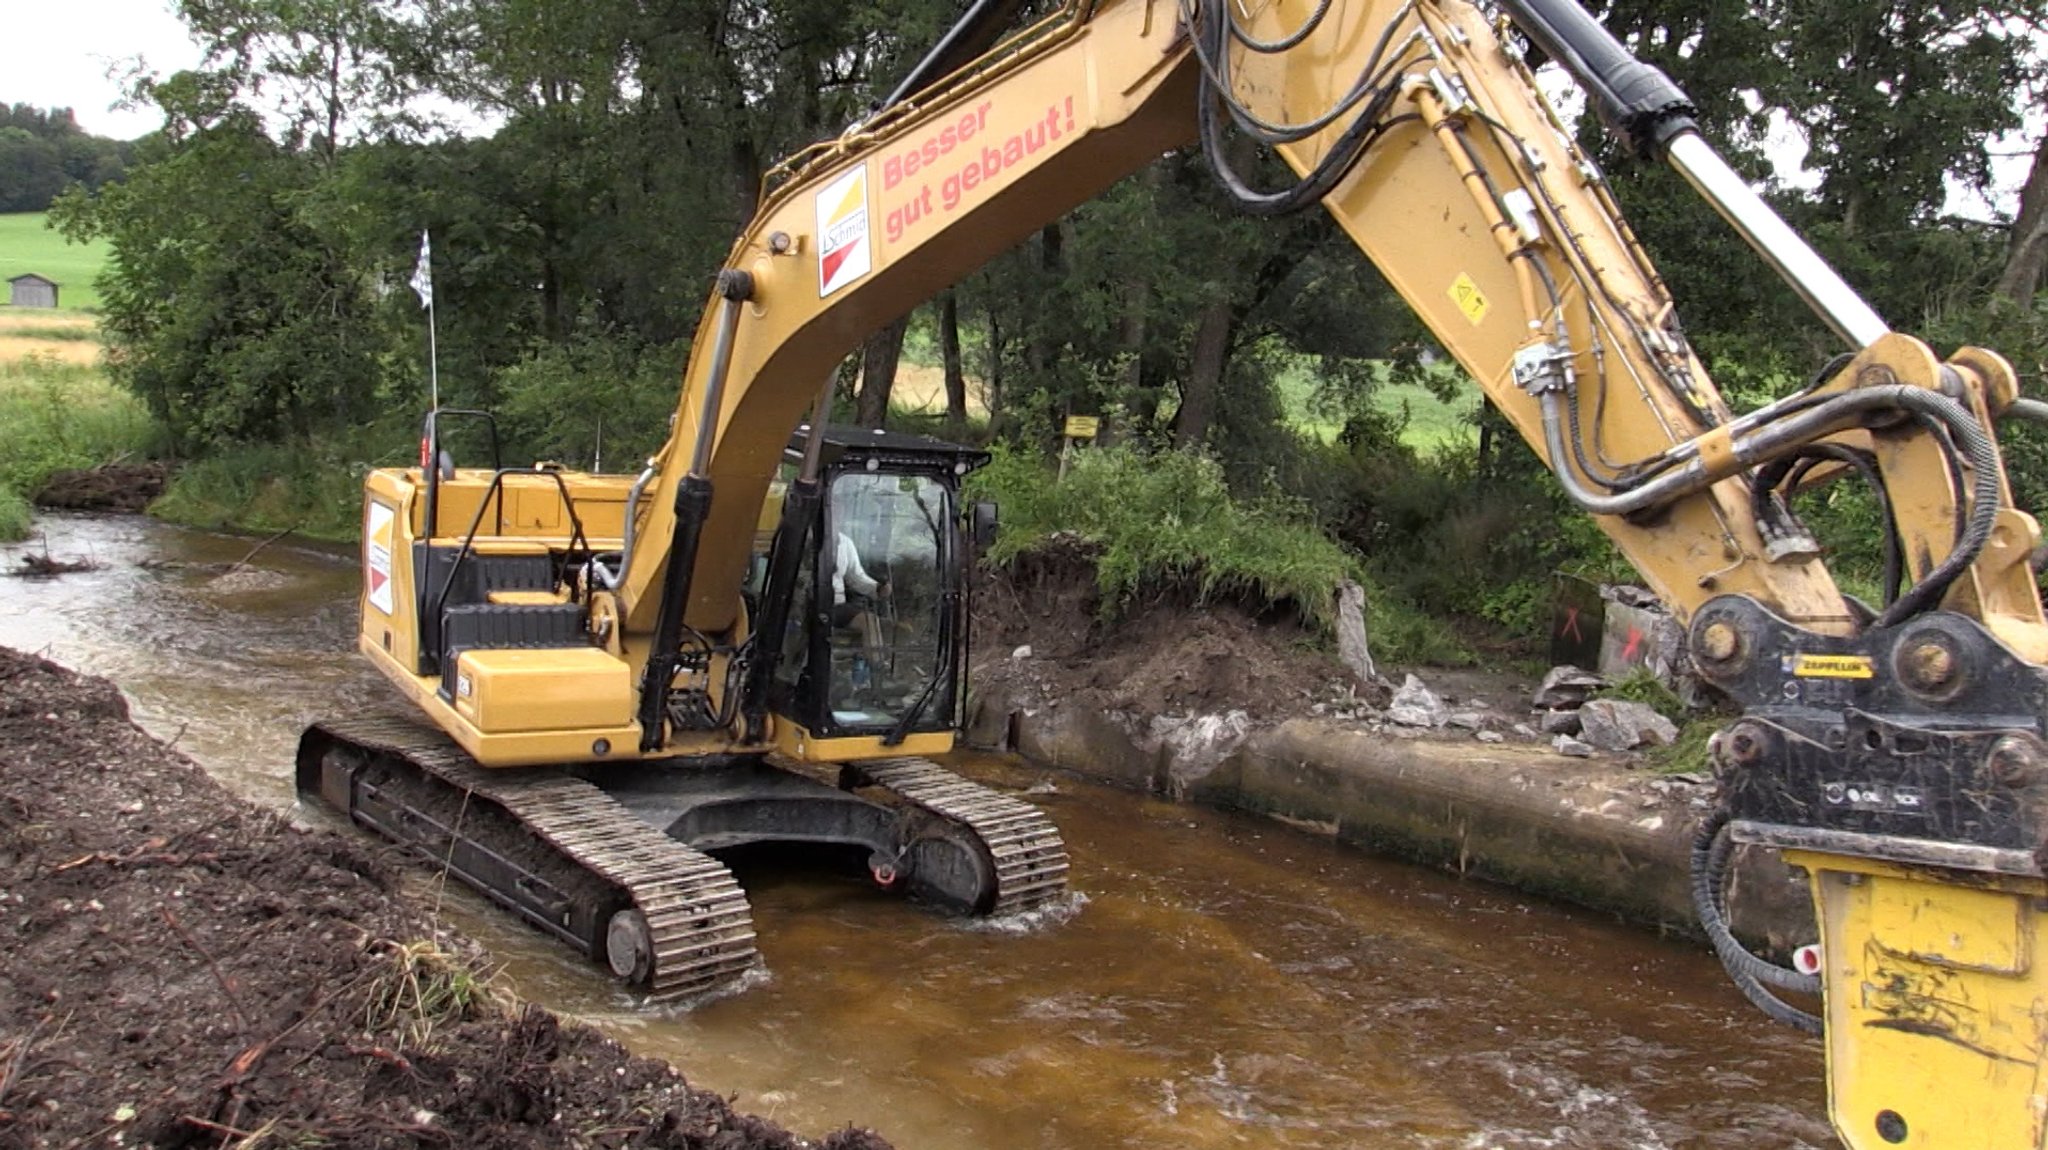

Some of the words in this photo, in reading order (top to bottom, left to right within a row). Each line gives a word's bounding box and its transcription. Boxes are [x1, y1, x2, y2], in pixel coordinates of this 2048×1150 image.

[883, 100, 993, 191] Besser
[886, 184, 933, 244] gut
[941, 96, 1076, 212] gebaut!
